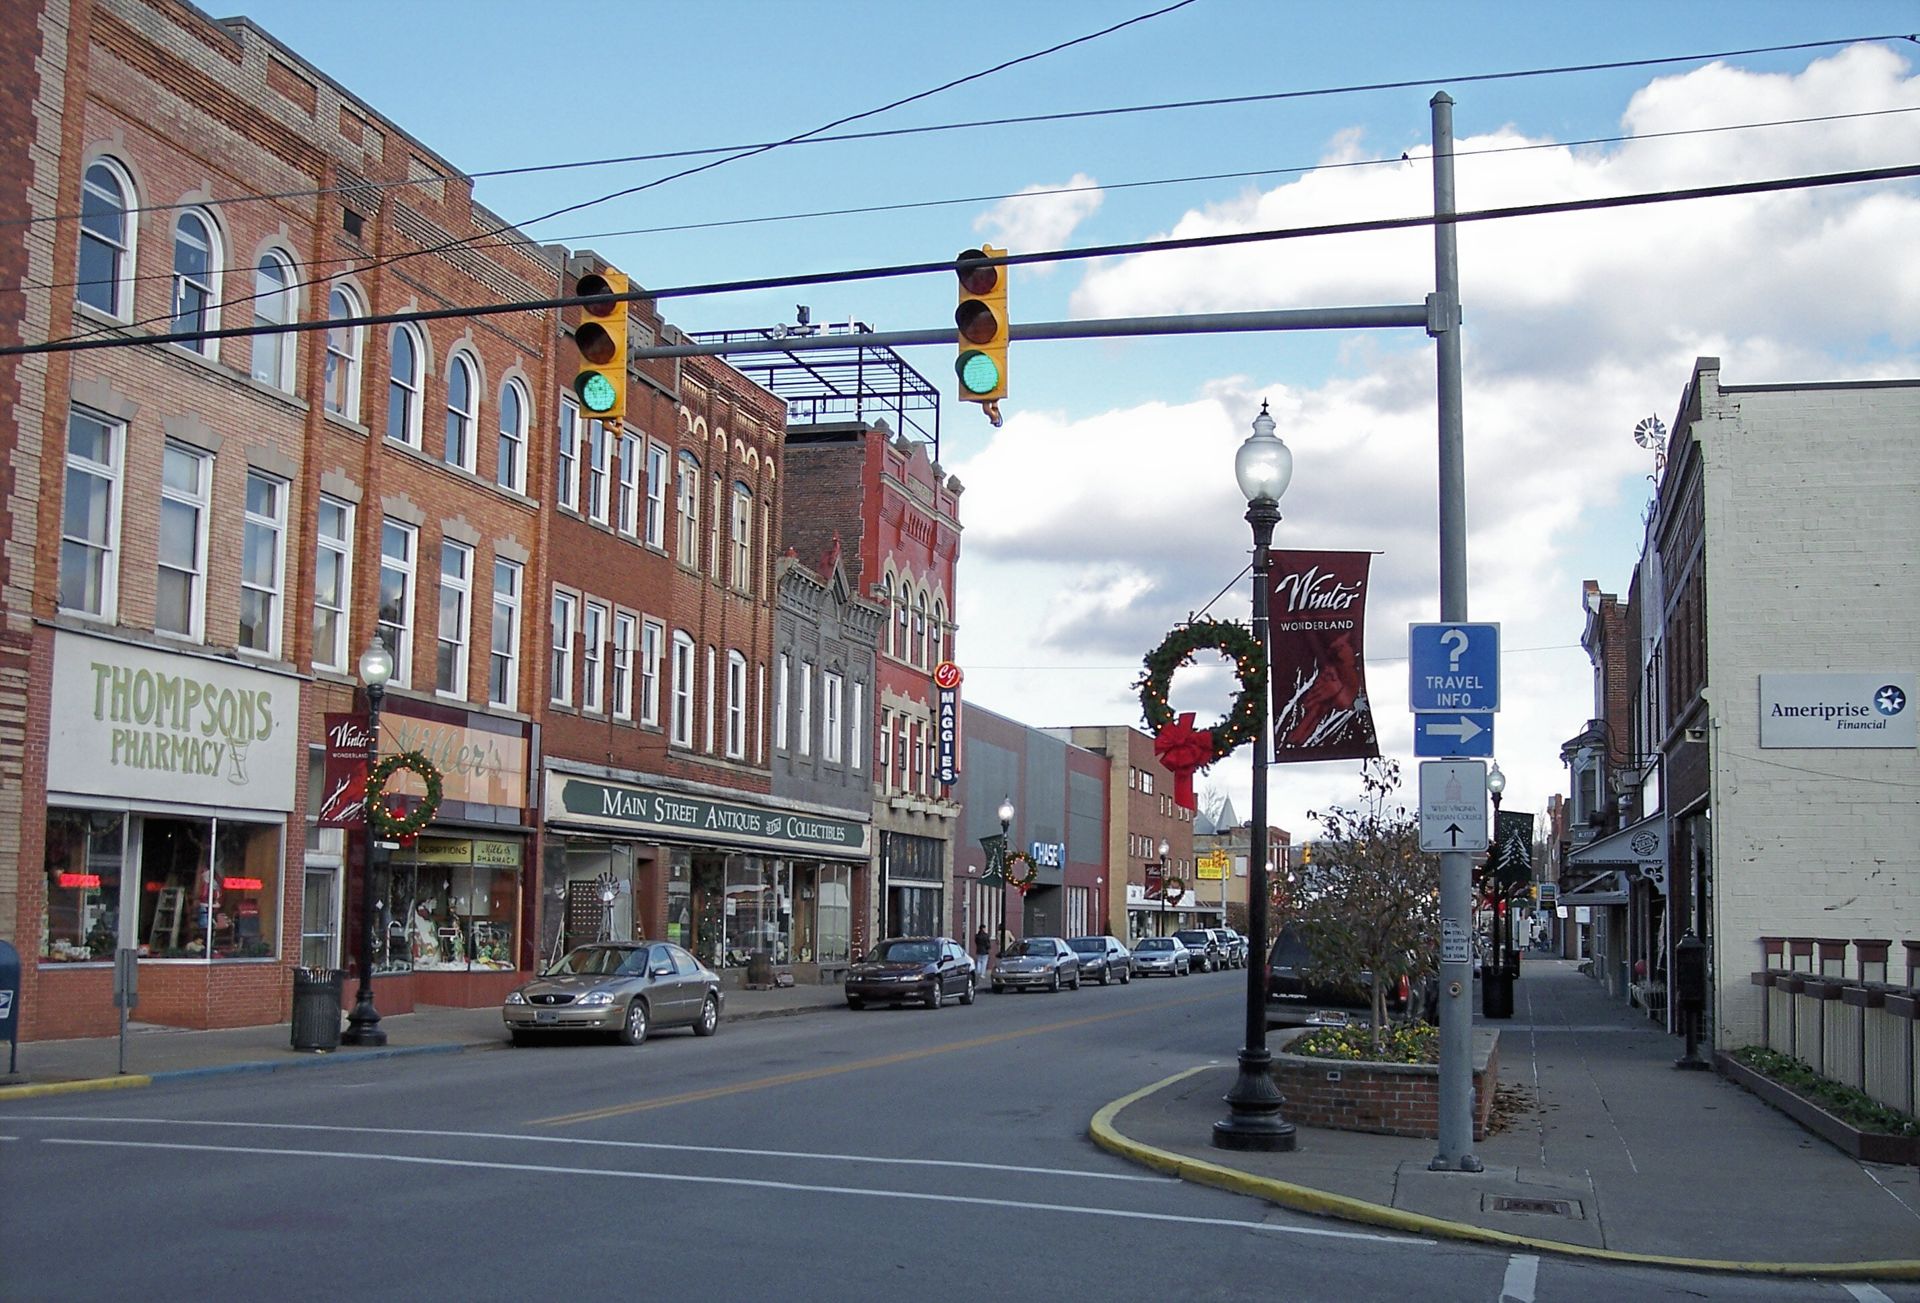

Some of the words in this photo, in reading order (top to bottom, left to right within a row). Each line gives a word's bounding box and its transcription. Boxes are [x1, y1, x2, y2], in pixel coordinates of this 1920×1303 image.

[1275, 566, 1362, 612] Winter
[1281, 620, 1354, 631] WONDERLAND
[1426, 676, 1483, 689] TRAVEL
[90, 662, 272, 741] THOMPSONS
[1437, 693, 1471, 706] INFO
[1771, 702, 1870, 720] Ameriprise
[330, 721, 370, 748] Winter
[941, 691, 955, 781] MAGGIES
[1836, 719, 1887, 730] Financial
[111, 728, 226, 777] PHARMACY
[1034, 842, 1058, 866] CHASE
